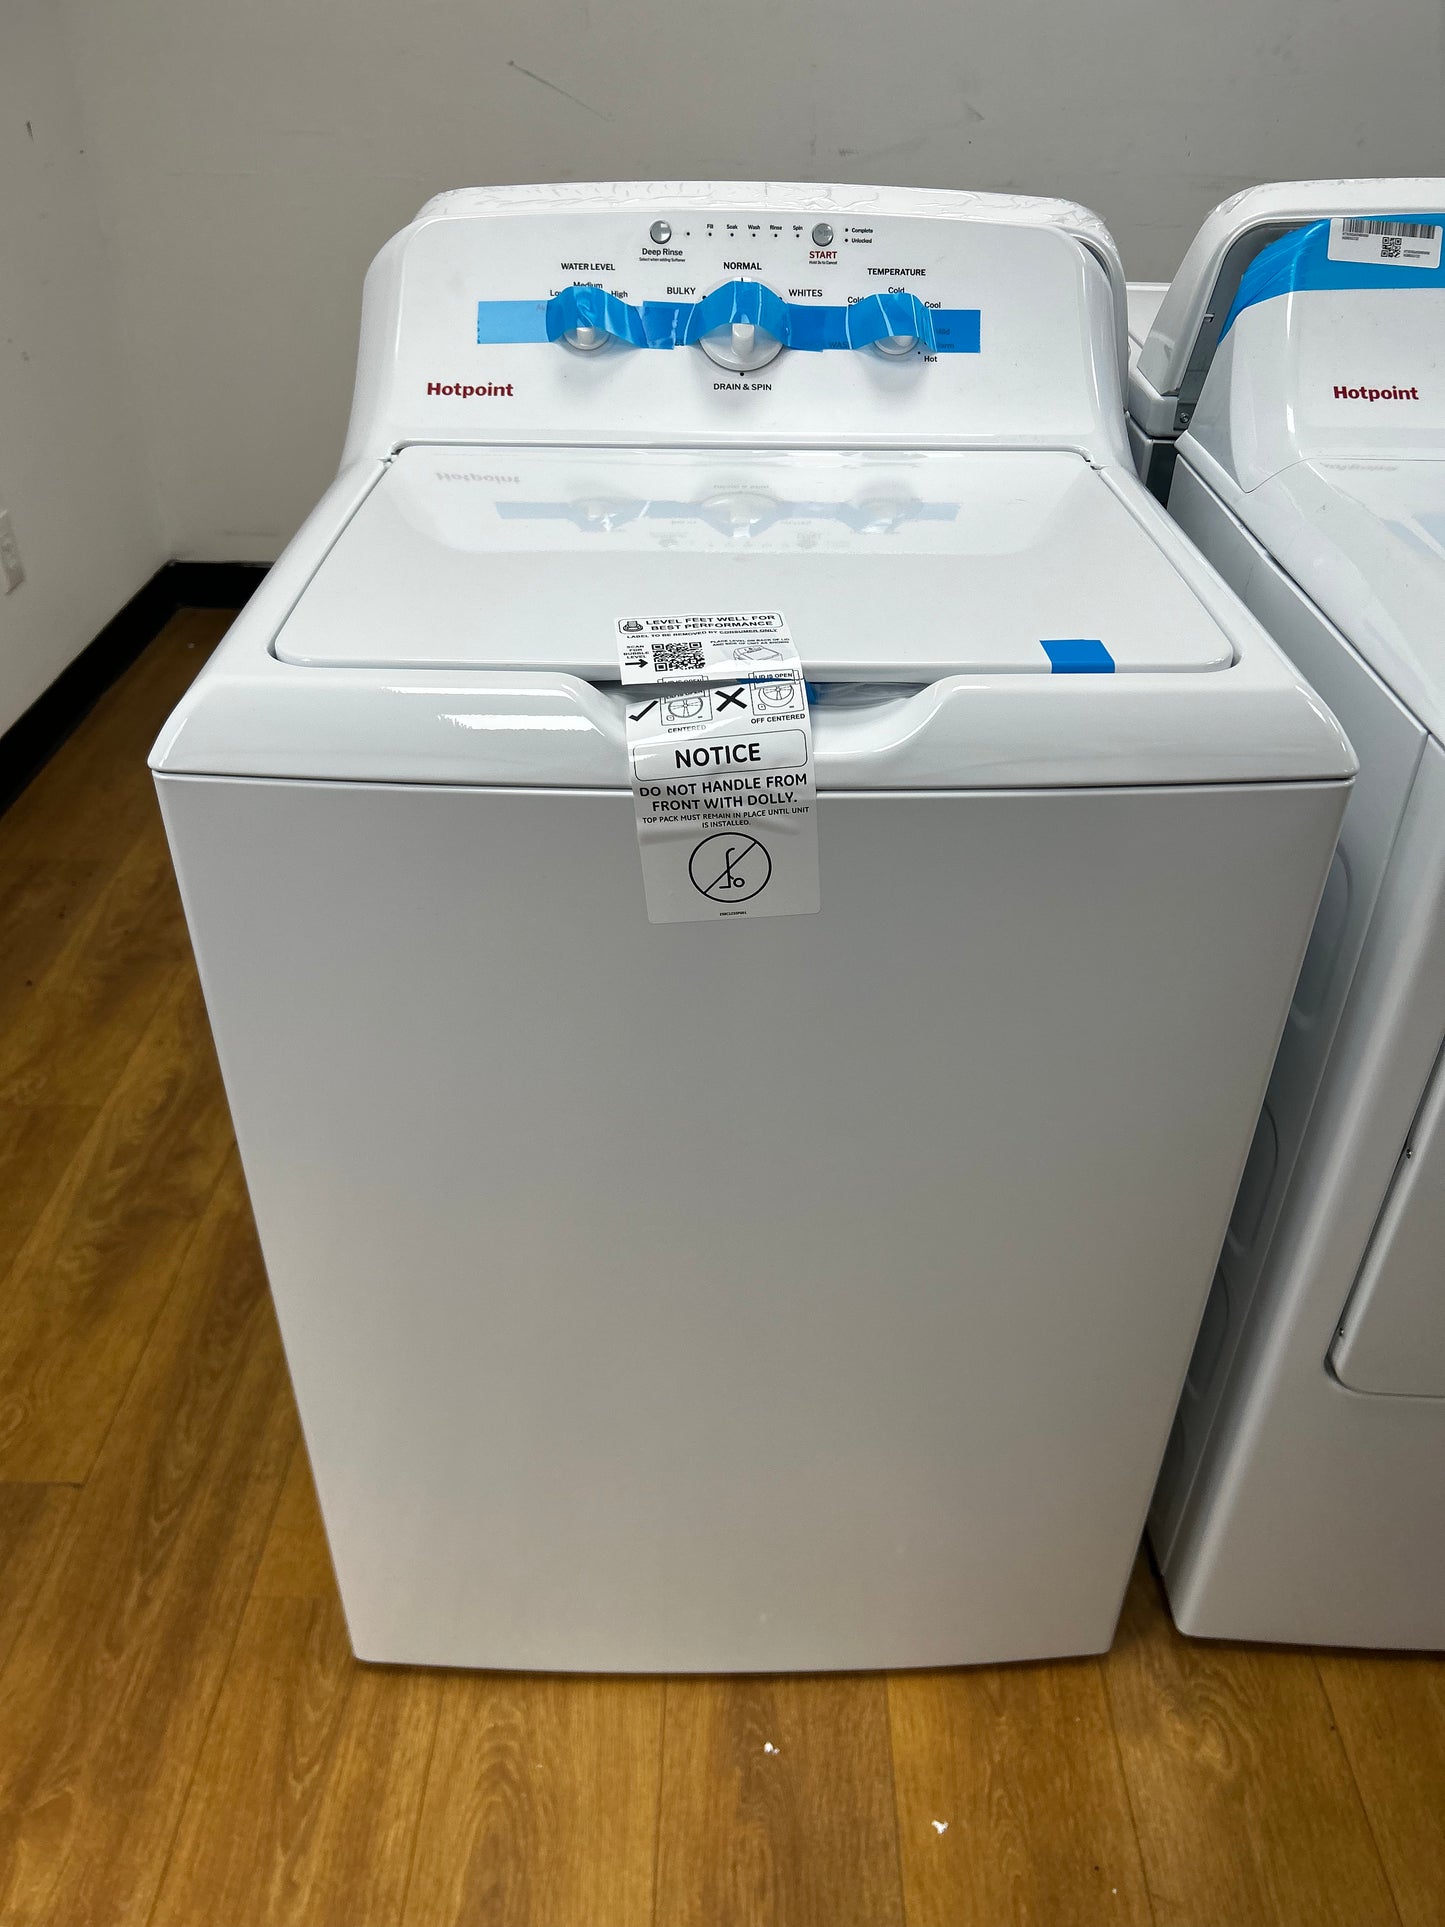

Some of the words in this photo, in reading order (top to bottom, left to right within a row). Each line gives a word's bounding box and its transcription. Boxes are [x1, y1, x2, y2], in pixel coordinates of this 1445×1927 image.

[642, 248, 661, 257] Deep
[662, 248, 683, 256] Rinse
[809, 250, 838, 259] START
[561, 263, 590, 271] WATER
[591, 263, 616, 271] LEVEL
[723, 262, 762, 270] NORMAL
[867, 268, 926, 276] TEMPERATURE
[611, 290, 628, 298] High
[666, 287, 696, 295] BULKY
[788, 289, 823, 297] WHITES
[924, 355, 938, 363] Hot
[427, 382, 514, 398] Hotpoint
[713, 383, 741, 391] DRAIN
[742, 383, 750, 391] &
[751, 383, 772, 391] SPIN
[1333, 385, 1419, 402] Hotpoint
[685, 621, 773, 629] PERFORMANCE
[750, 717, 764, 725] OFF
[765, 713, 805, 723] CENTERED
[668, 725, 707, 733] CENTERED
[675, 742, 761, 769] NOTICE
[639, 786, 661, 797] DO
[666, 783, 697, 796] NOT
[702, 777, 761, 794] HANDLE
[766, 773, 807, 788] FROM
[652, 799, 700, 812] FRONT
[704, 796, 743, 809] WITH
[748, 792, 797, 806] DOLLY.
[702, 812, 731, 820] REMAIN
[743, 810, 766, 818] PLACE
[768, 808, 789, 816] UNTIL
[791, 806, 810, 814] UNIT
[710, 819, 750, 828] INSTALLED.
